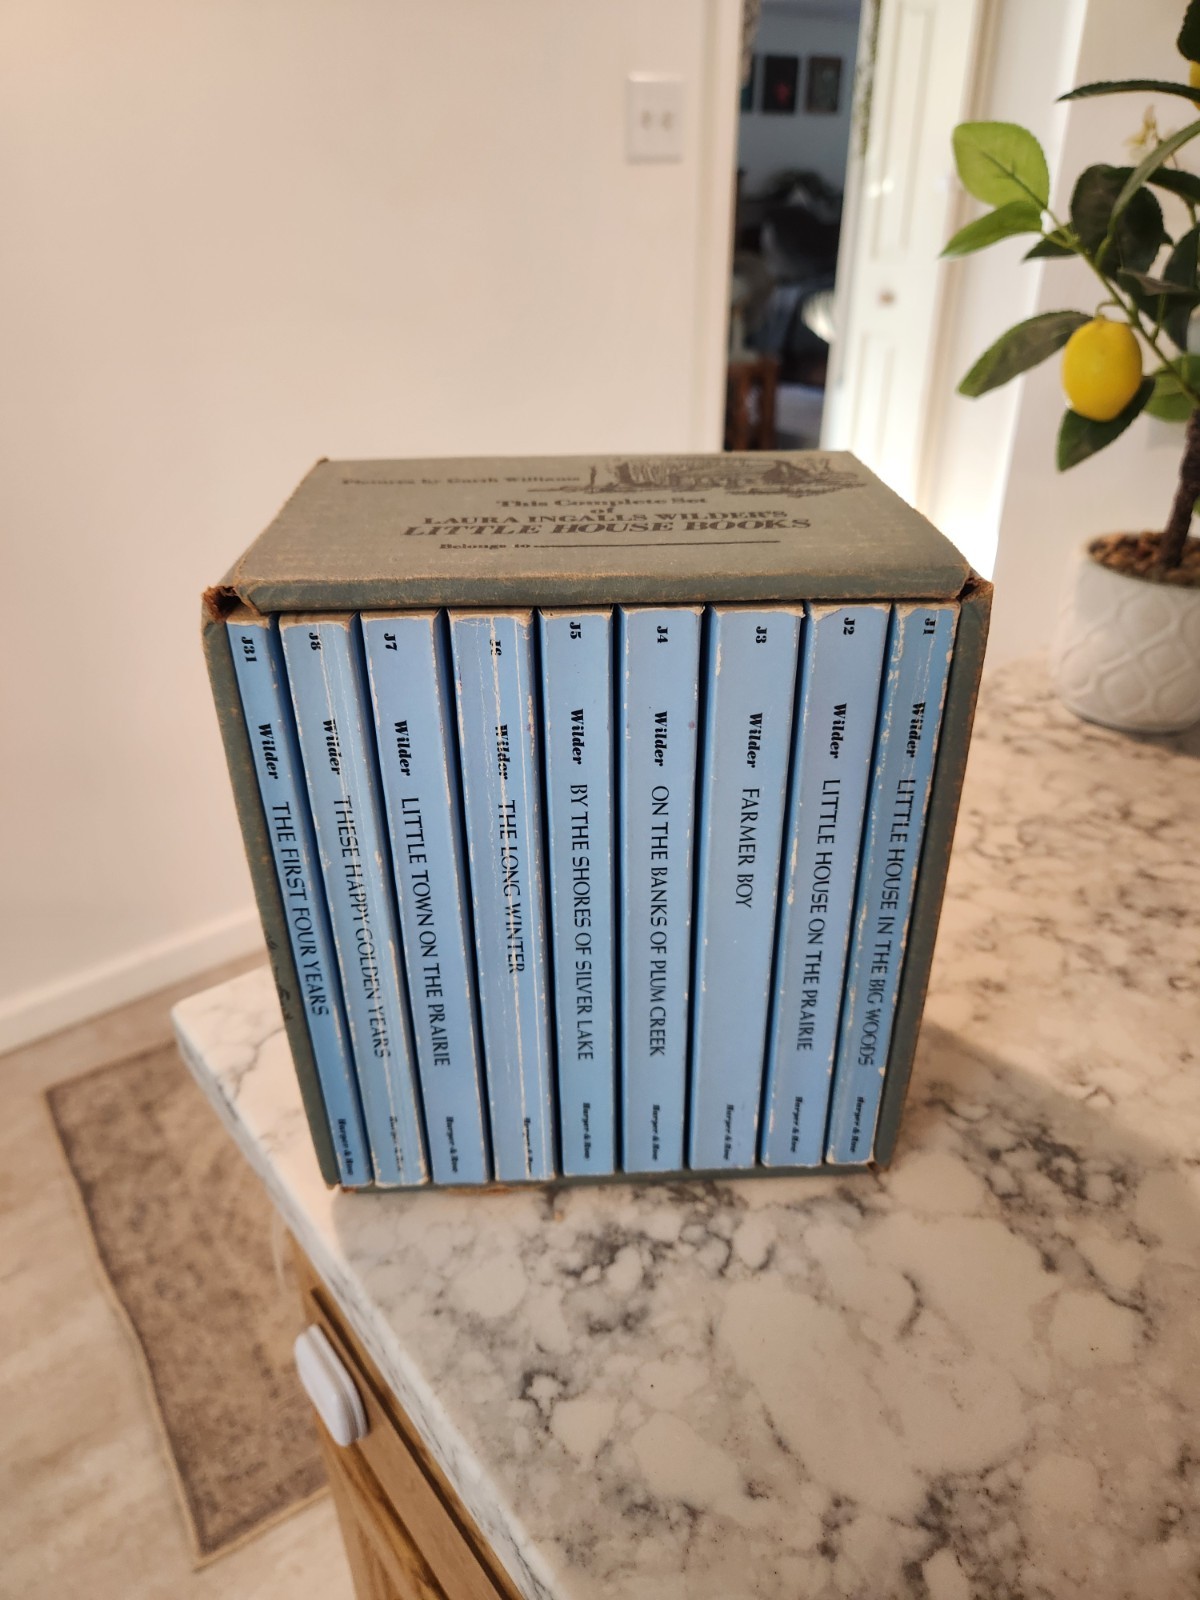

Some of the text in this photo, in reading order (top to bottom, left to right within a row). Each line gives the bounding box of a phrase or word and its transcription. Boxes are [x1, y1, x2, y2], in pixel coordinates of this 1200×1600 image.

[423, 511, 787, 524] LAURA INGALLS WILDER'S
[554, 499, 667, 507] Complete
[402, 519, 811, 536] LITTLE HOUSE BOOKS
[241, 636, 257, 662] J31
[384, 633, 397, 651] J7
[570, 622, 582, 639] J5
[656, 625, 668, 643] J4
[755, 626, 767, 644] J3
[843, 617, 856, 635] J2
[923, 617, 936, 635] J1
[258, 723, 278, 780] Wilder
[394, 720, 412, 776] Wilder
[495, 724, 510, 780] Wilder
[570, 708, 585, 765] Wilder
[654, 711, 668, 767] Wilder
[746, 712, 763, 769] Wilder
[829, 702, 847, 759] Wilder
[906, 702, 926, 758] Wilder
[570, 784, 588, 807] BY
[651, 785, 670, 816] ON
[817, 779, 840, 844] LITTLE
[890, 779, 916, 843] LITTLE
[272, 801, 296, 842] THE
[401, 798, 427, 863] LITTLE
[498, 800, 517, 839] THE
[570, 811, 589, 851] THE
[651, 822, 669, 860] THE
[738, 788, 760, 866] FARMER
[309, 632, 391, 1058] J8 Wilder THESE HAPPY GOLDEN YEARS
[281, 849, 307, 900] FIRST
[501, 847, 521, 897] LONG
[573, 856, 591, 928] SHORES
[735, 874, 754, 909] BOY
[810, 852, 833, 914] HOUSE
[880, 849, 905, 910] HOUSE
[411, 870, 435, 926] TOWN
[650, 867, 668, 927] BANKS
[292, 907, 318, 957] FOUR
[419, 930, 438, 957] ON
[505, 903, 525, 974] WINTER
[574, 932, 592, 955] OF
[650, 931, 667, 954] OF
[807, 918, 826, 945] ON
[877, 916, 895, 935] IN
[803, 951, 822, 985] THE
[871, 940, 892, 974] THE
[303, 960, 329, 1016] YEARS
[423, 963, 444, 998] THE
[575, 960, 593, 1016] SILVER
[649, 960, 667, 1002] PLUM
[866, 978, 886, 1005] BIG
[428, 1004, 450, 1066] PRAIRIE
[576, 1020, 594, 1061] LAKE
[649, 1006, 666, 1057] CREEK
[796, 990, 818, 1051] PRAIRIE
[858, 1008, 884, 1066] WOODS
